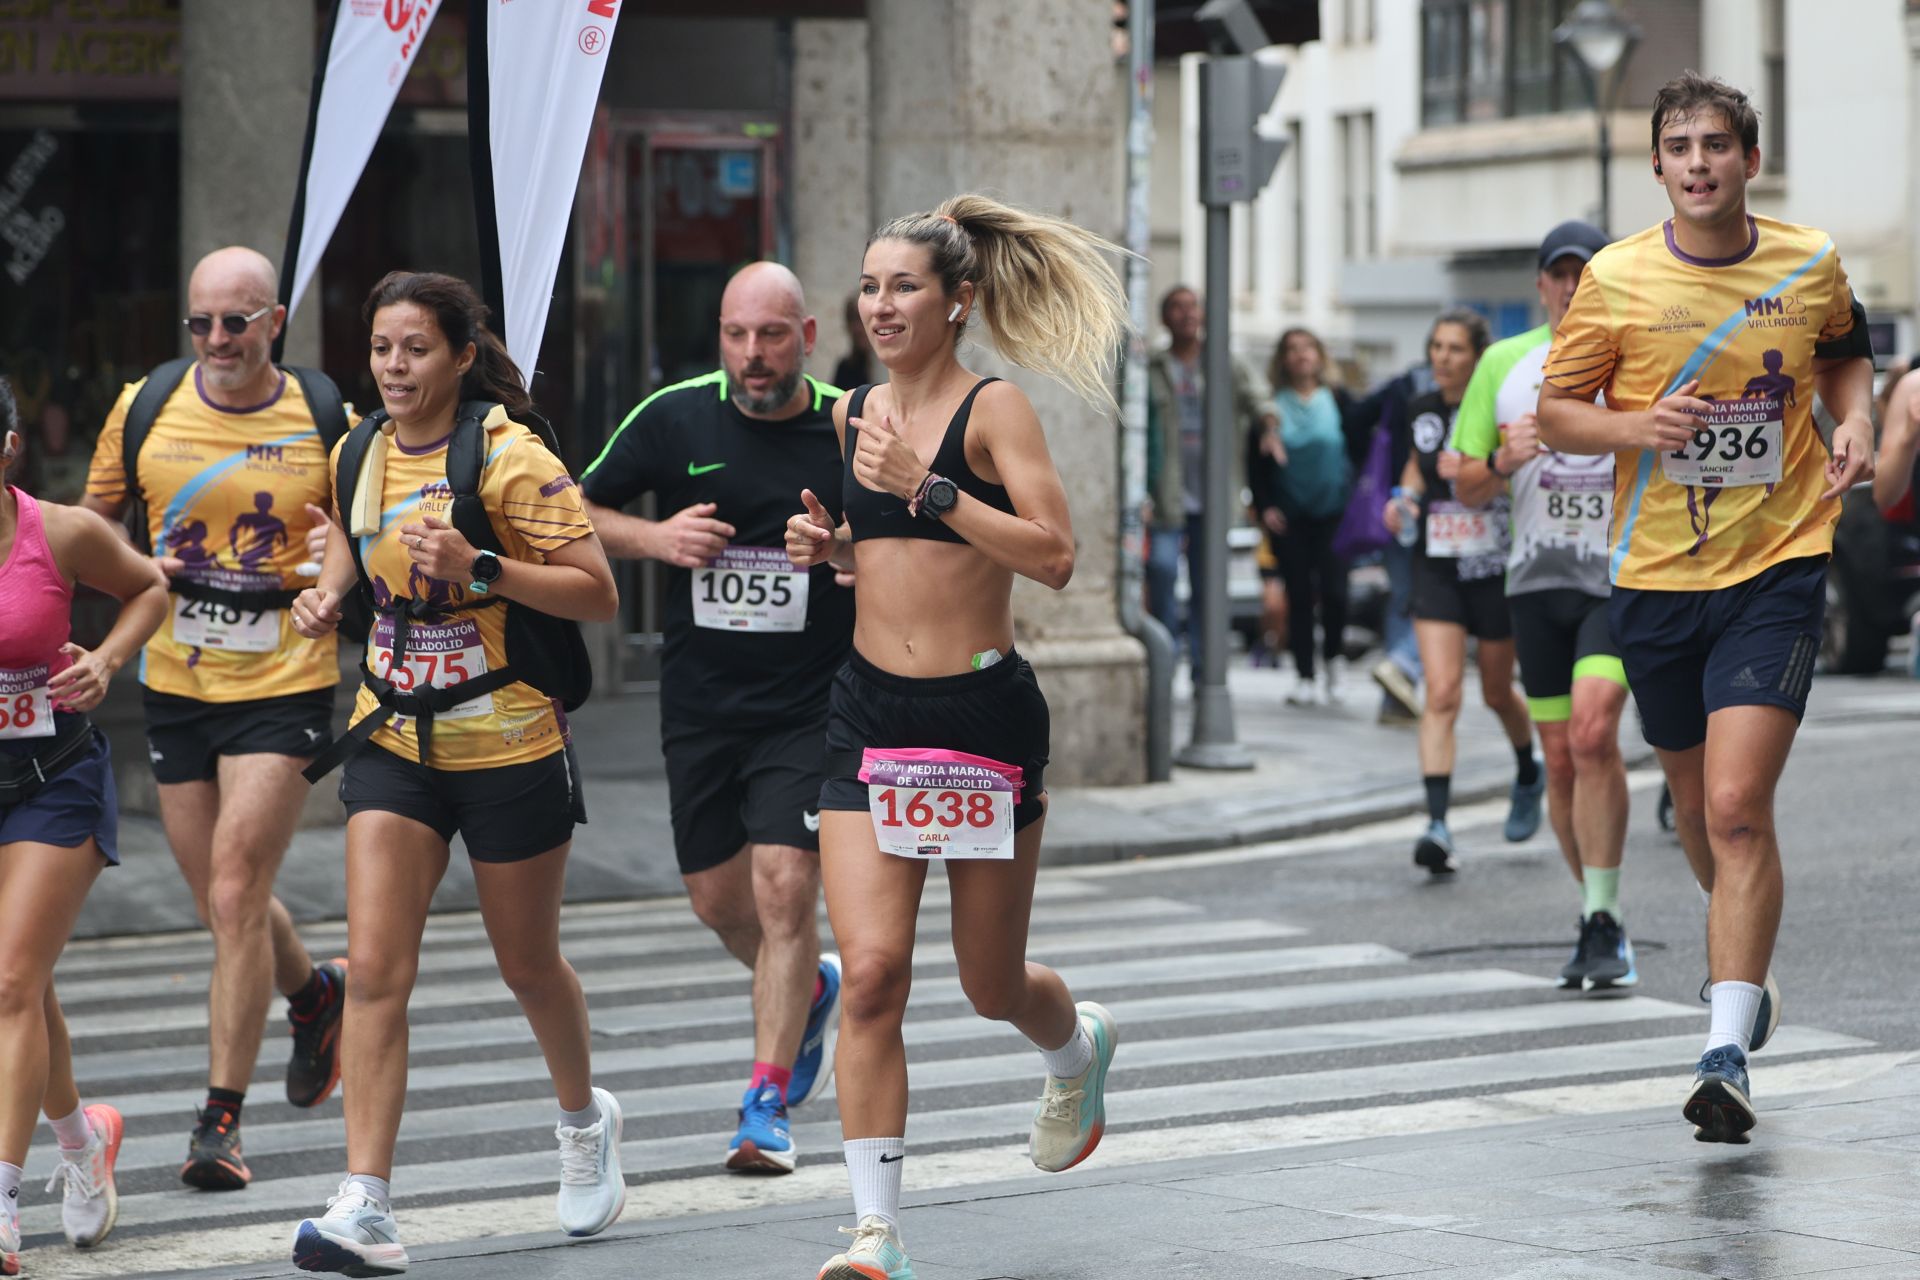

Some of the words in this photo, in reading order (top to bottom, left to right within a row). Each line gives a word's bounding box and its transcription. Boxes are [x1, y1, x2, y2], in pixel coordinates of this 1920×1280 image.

[1744, 296, 1807, 316] MM25
[1748, 316, 1808, 328] VALLADOLID
[1548, 493, 1604, 520] 853
[700, 571, 792, 607] 1055
[422, 621, 475, 640] MARATÓN
[405, 639, 464, 652] ALLADOLID
[907, 764, 946, 776] MEDIA
[897, 776, 912, 786] DE
[915, 778, 992, 789] VALLADOLID
[877, 788, 995, 828] 1638
[918, 833, 950, 842] CARLA
